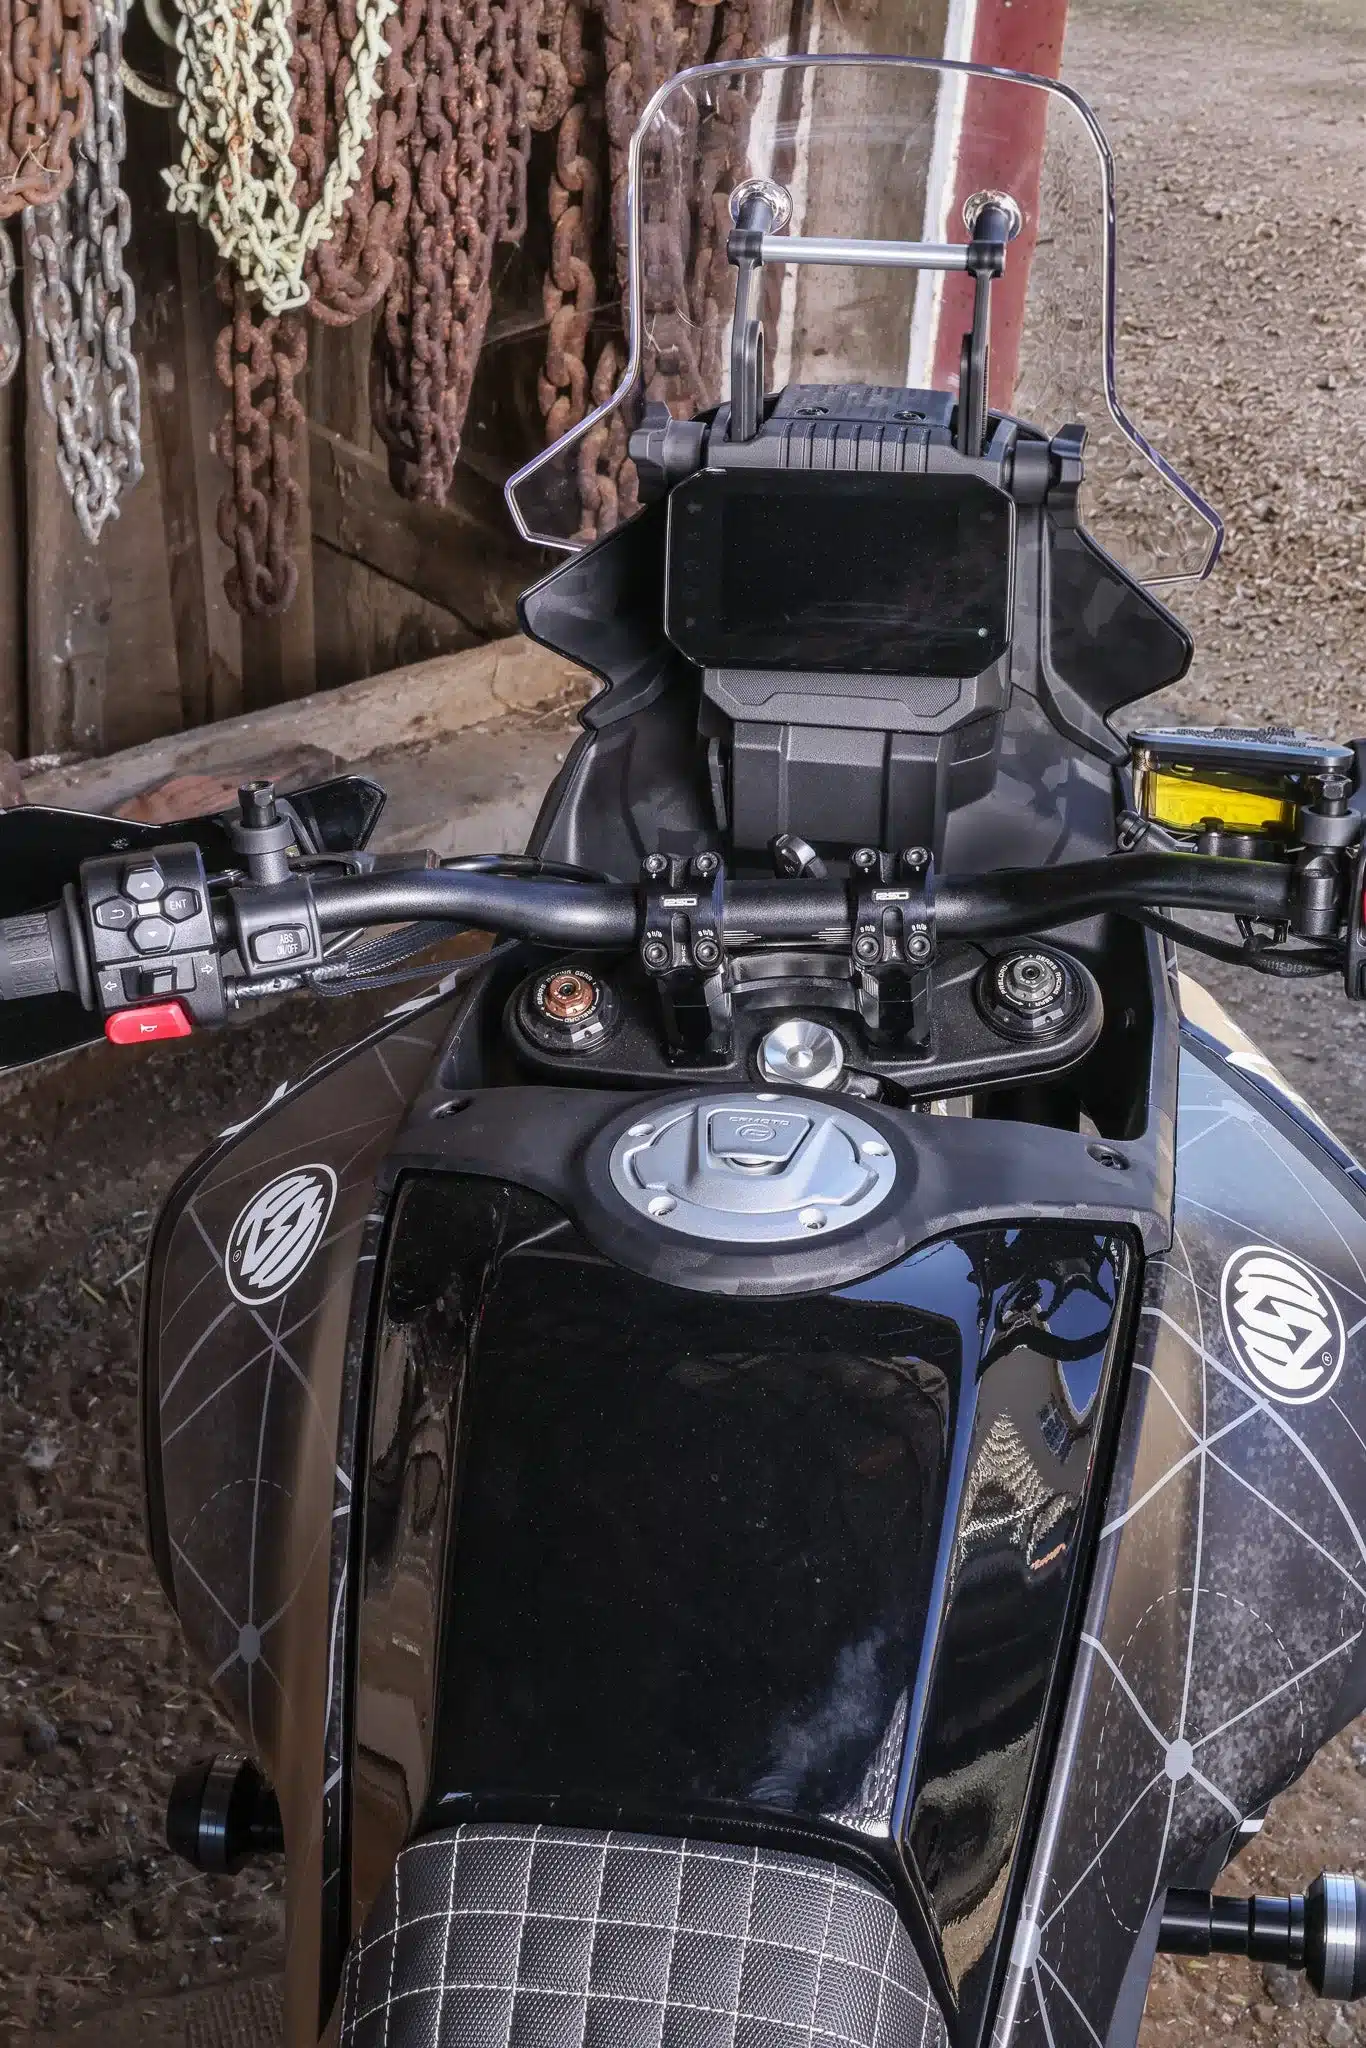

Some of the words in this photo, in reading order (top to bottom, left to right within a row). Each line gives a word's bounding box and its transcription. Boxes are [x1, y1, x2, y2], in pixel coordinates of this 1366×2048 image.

[169, 899, 188, 911] ENT
[280, 933, 294, 944] ABS
[276, 944, 299, 956] ON/OFF
[1035, 954, 1058, 971] GEARS
[997, 964, 1009, 995] PRELOAD
[536, 983, 547, 1006] GEARS
[574, 970, 593, 982] GEAR
[1034, 995, 1054, 1007] GEAR
[564, 1005, 597, 1023] PRELOAD
[728, 1116, 791, 1126] CFMOTO
